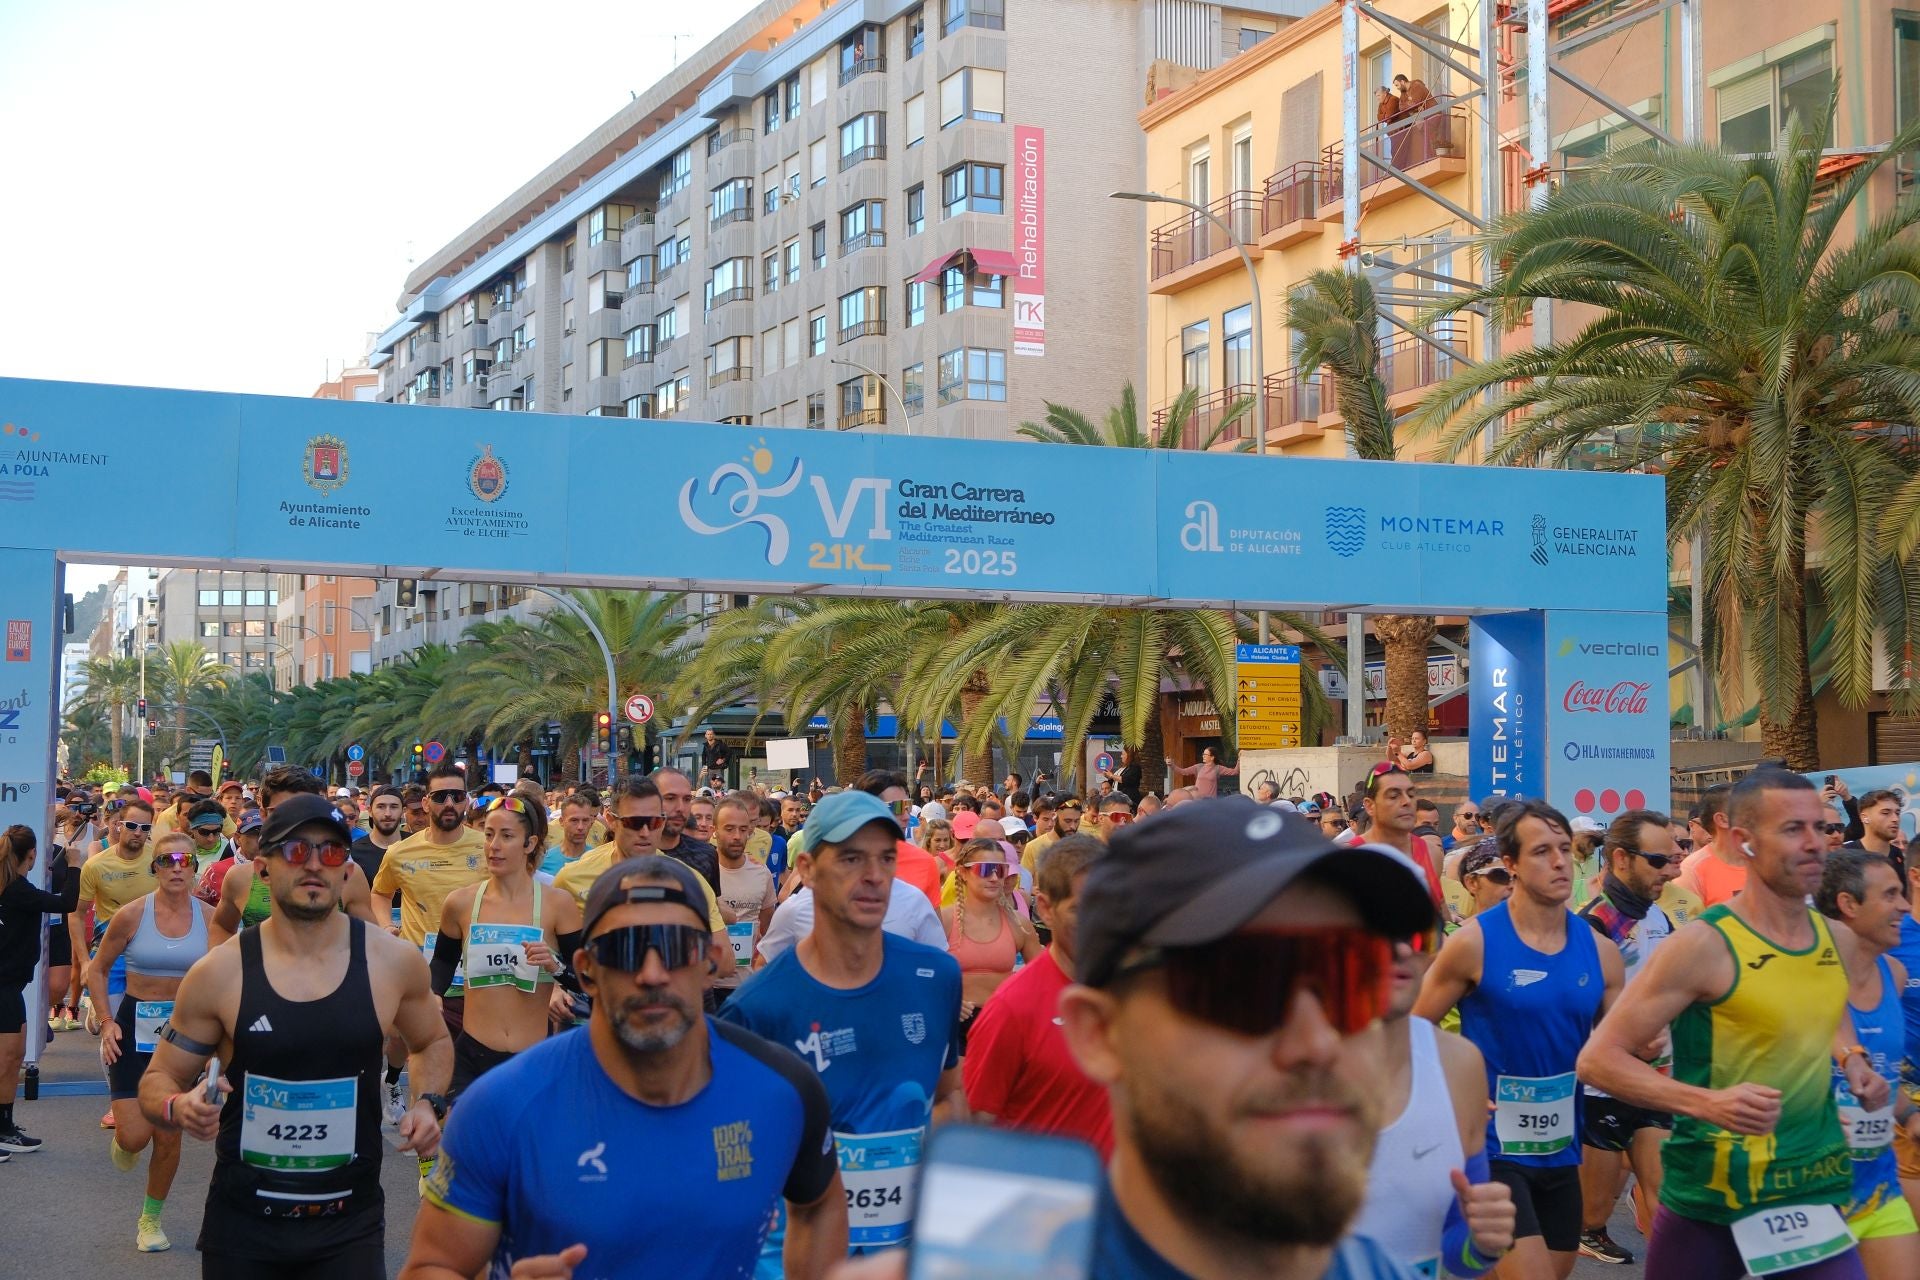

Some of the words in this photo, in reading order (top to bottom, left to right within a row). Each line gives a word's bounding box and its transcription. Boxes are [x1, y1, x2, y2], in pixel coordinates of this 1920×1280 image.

[1020, 137, 1037, 280] Rehabilitación
[16, 450, 109, 466] AJUNTAMENT
[14, 464, 49, 477] POLA
[898, 479, 948, 500] Gran
[951, 482, 1026, 503] Carrera
[279, 500, 371, 517] Ayuntamiento
[810, 475, 892, 540] VI
[898, 501, 928, 519] del
[932, 503, 1056, 526] Mediterráneo
[288, 515, 305, 527] de
[308, 517, 361, 530] Alicante
[445, 517, 529, 530] AYUNTAMIENTO
[899, 520, 921, 532] The
[924, 522, 973, 534] Greatest
[1381, 516, 1505, 537] MONTEMAR
[463, 528, 475, 537] de
[478, 528, 510, 538] ELCHE
[899, 531, 985, 545] Mediterranean
[988, 535, 1015, 546] Race
[1230, 529, 1301, 541] DIPUTACIÓN
[1553, 527, 1639, 542] GENERALITAT
[899, 547, 930, 556] Alicante
[1230, 543, 1244, 552] DE
[1248, 544, 1301, 555] ALICANTE
[1381, 541, 1411, 551] CLUB
[1554, 543, 1636, 557] VALENCIANA
[808, 542, 892, 571] 21K
[944, 549, 1018, 576] 2025
[9, 622, 31, 633] ENJOY
[8, 641, 30, 649] EUROPE
[1579, 642, 1659, 656] vectalia
[1200, 720, 1221, 731] AMSTEL
[1492, 668, 1507, 797] NTEMAR
[1514, 694, 1523, 783] ATLÉTICO
[1582, 745, 1600, 759] HLA
[1601, 747, 1656, 760] VISTAHERMOSA
[486, 954, 519, 967] 1614
[272, 1090, 289, 1103] VI
[1522, 1086, 1537, 1097] VI
[1518, 1113, 1560, 1129] 3190
[267, 1124, 328, 1141] 4223
[713, 1120, 753, 1149] 100%
[716, 1146, 754, 1168] TRAIL
[847, 1147, 867, 1163] VI
[1774, 1168, 1796, 1189] EL
[844, 1185, 902, 1209] 2634
[1763, 1211, 1809, 1235] 1219
